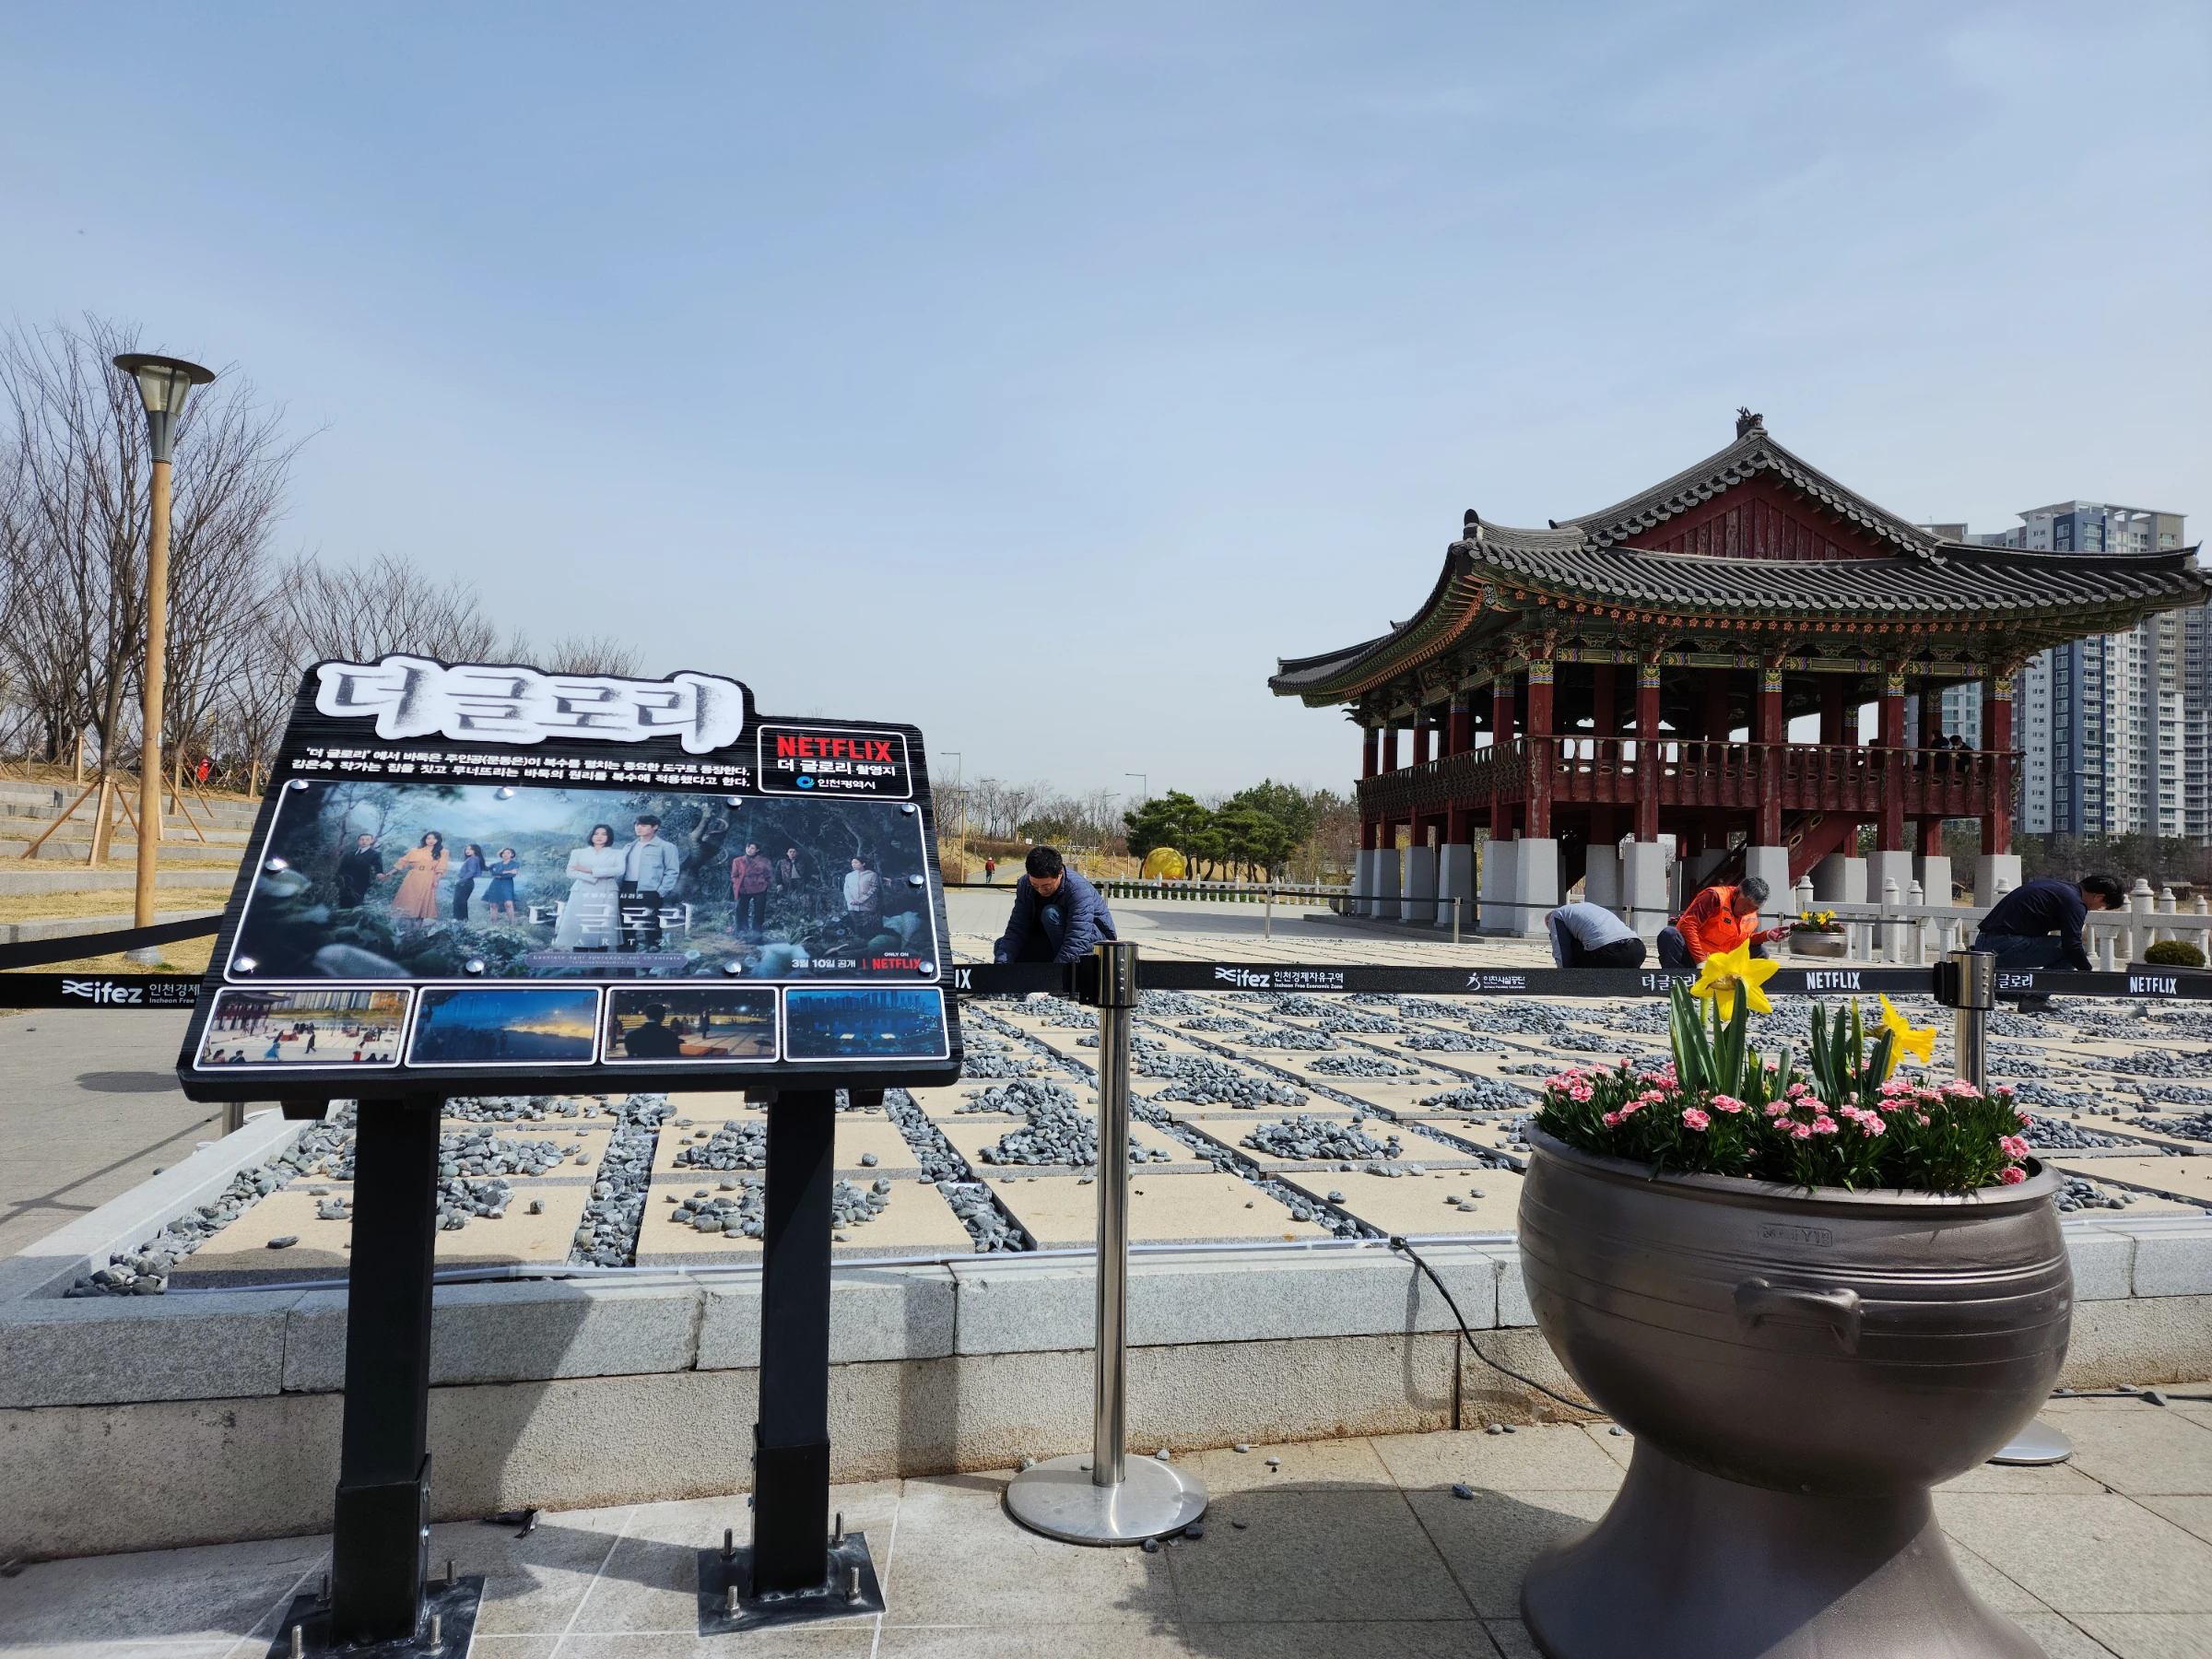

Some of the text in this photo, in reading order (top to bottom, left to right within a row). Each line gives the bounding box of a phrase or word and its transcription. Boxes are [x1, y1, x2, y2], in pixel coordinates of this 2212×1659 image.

[777, 735, 892, 762] NETFLIX
[373, 750, 399, 761] 에서
[403, 752, 442, 763] 바둑은
[445, 754, 541, 766] 주인공(문동은)이
[543, 758, 581, 769] 복수를
[584, 759, 620, 771] 펼치는
[623, 761, 660, 772] 중요한
[662, 763, 698, 773] 도구로
[700, 765, 751, 776] 등장한다.
[777, 759, 896, 776] 더 글로리 촬영지
[291, 759, 751, 787] 김은숙 작가는 집을 짓고 무너뜨리는 바둑의 원리를 복수에 적용했다고 한다.
[817, 779, 877, 790] 인천광역시
[791, 959, 856, 969] 3월 10일 공개
[872, 958, 921, 971] NETFLIX
[1237, 969, 1270, 988] ifez
[1274, 971, 1344, 983] 인천경제자유구역
[1483, 975, 1525, 984] 인천시설공단
[1806, 972, 1861, 990] NETFLIX
[2130, 977, 2177, 994] NETFLIX
[94, 981, 143, 1004] ifez
